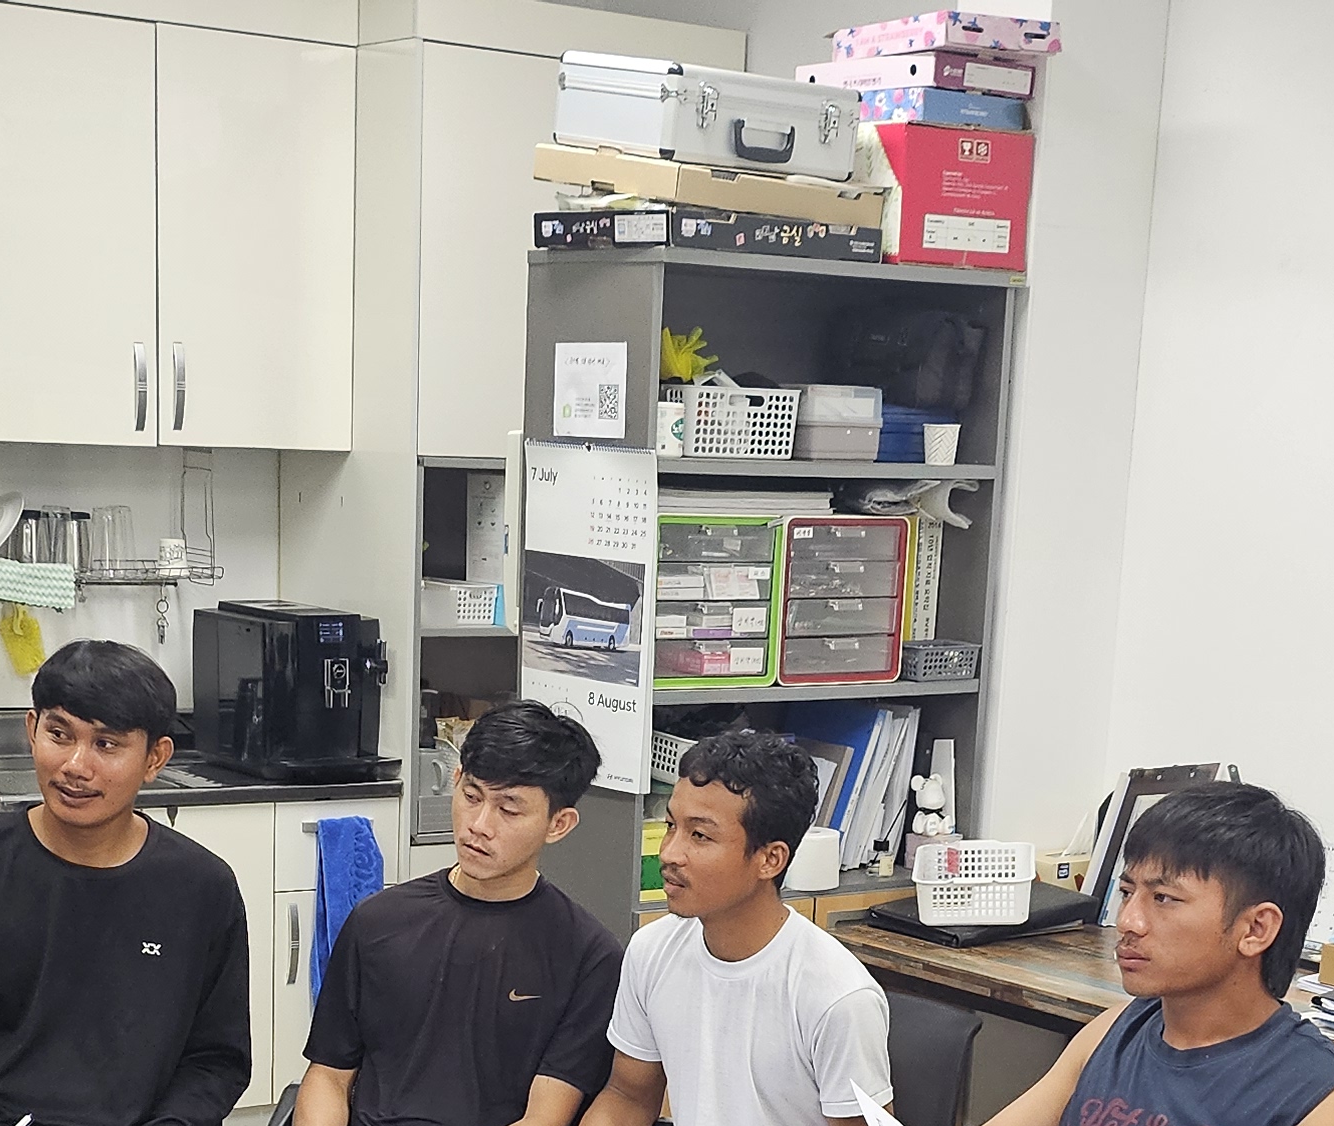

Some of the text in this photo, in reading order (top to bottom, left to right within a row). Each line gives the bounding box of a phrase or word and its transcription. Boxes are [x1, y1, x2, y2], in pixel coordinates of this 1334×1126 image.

[531, 467, 559, 486] 7 July
[588, 691, 637, 713] 8 August
